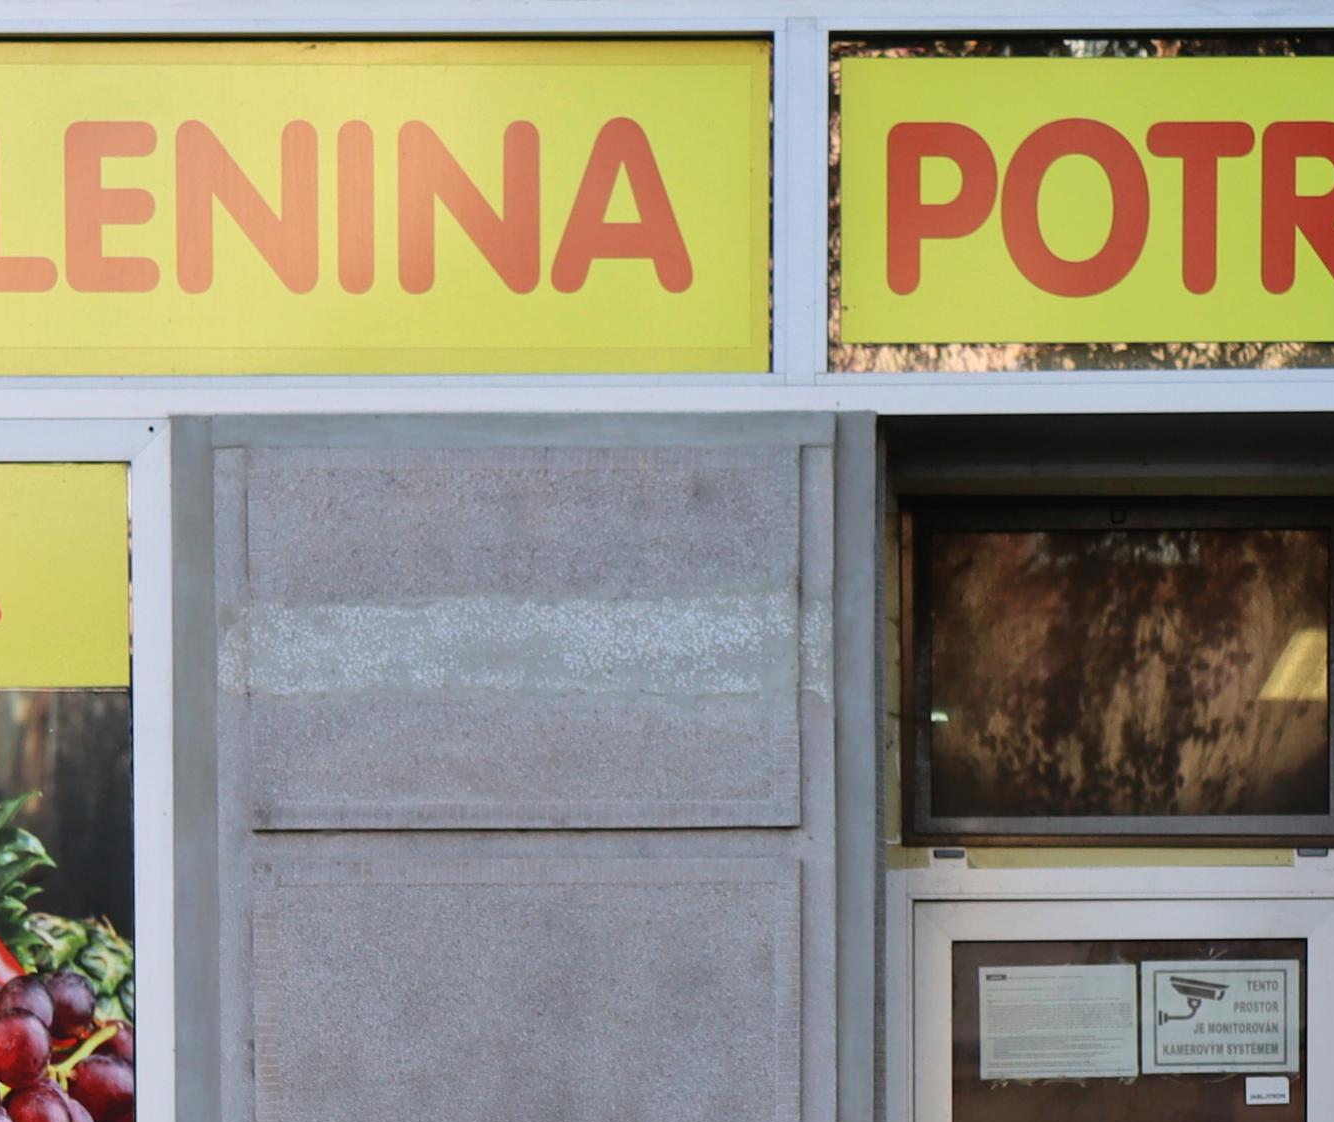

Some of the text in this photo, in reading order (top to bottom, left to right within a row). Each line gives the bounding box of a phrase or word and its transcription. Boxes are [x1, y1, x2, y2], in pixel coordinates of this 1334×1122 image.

[1246, 980, 1279, 992] TENTO
[1233, 1001, 1279, 1013] PROSTOR
[1193, 1023, 1205, 1034] JE
